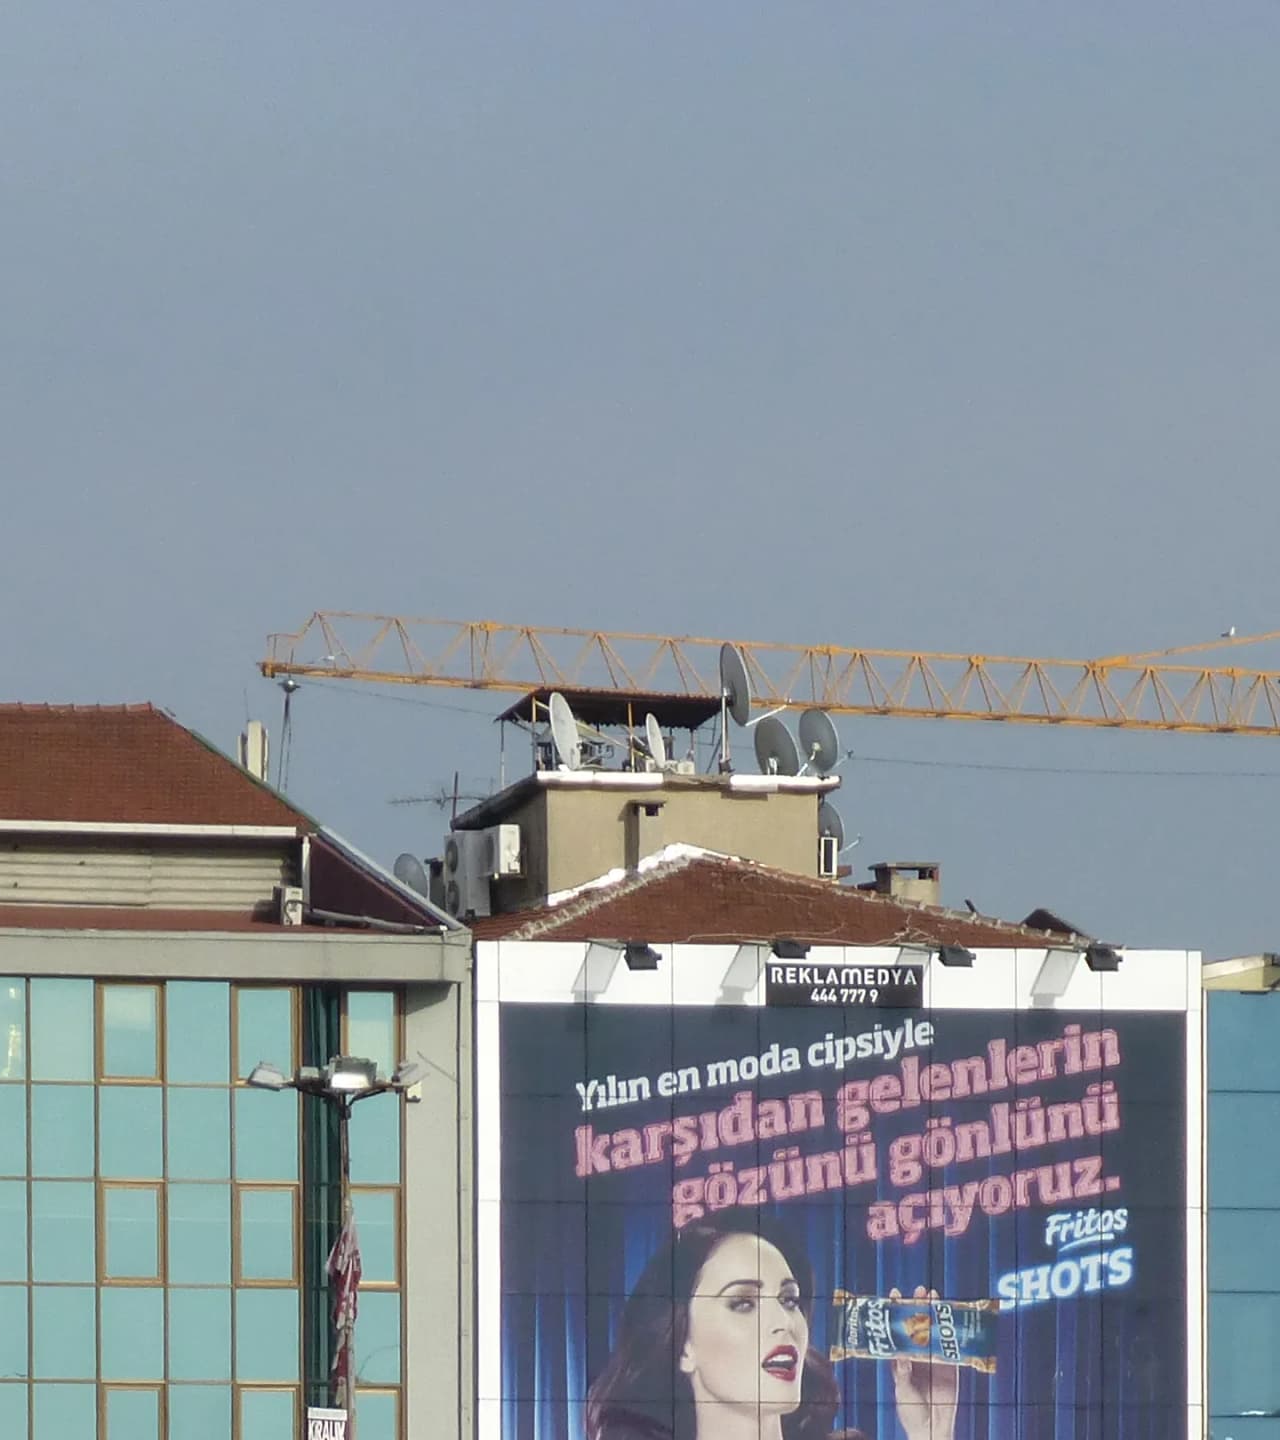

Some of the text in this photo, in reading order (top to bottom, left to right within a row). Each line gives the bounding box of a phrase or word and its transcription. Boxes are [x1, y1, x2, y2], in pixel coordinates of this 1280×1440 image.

[771, 967, 917, 985] REKLAMEDYA
[810, 988, 879, 1003] 444 777 9
[575, 1018, 935, 1111] Yılın en moda cipsiyle
[574, 1023, 1121, 1177] karşıdan gelenlerin
[672, 1080, 1120, 1229] gözünü gönlünü
[867, 1155, 1120, 1245] açıyoruz.
[1045, 1207, 1129, 1248] Fritos
[997, 1247, 1134, 1311] SHOTS
[867, 1298, 890, 1357] Fritos
[935, 1302, 960, 1361] SHOTS
